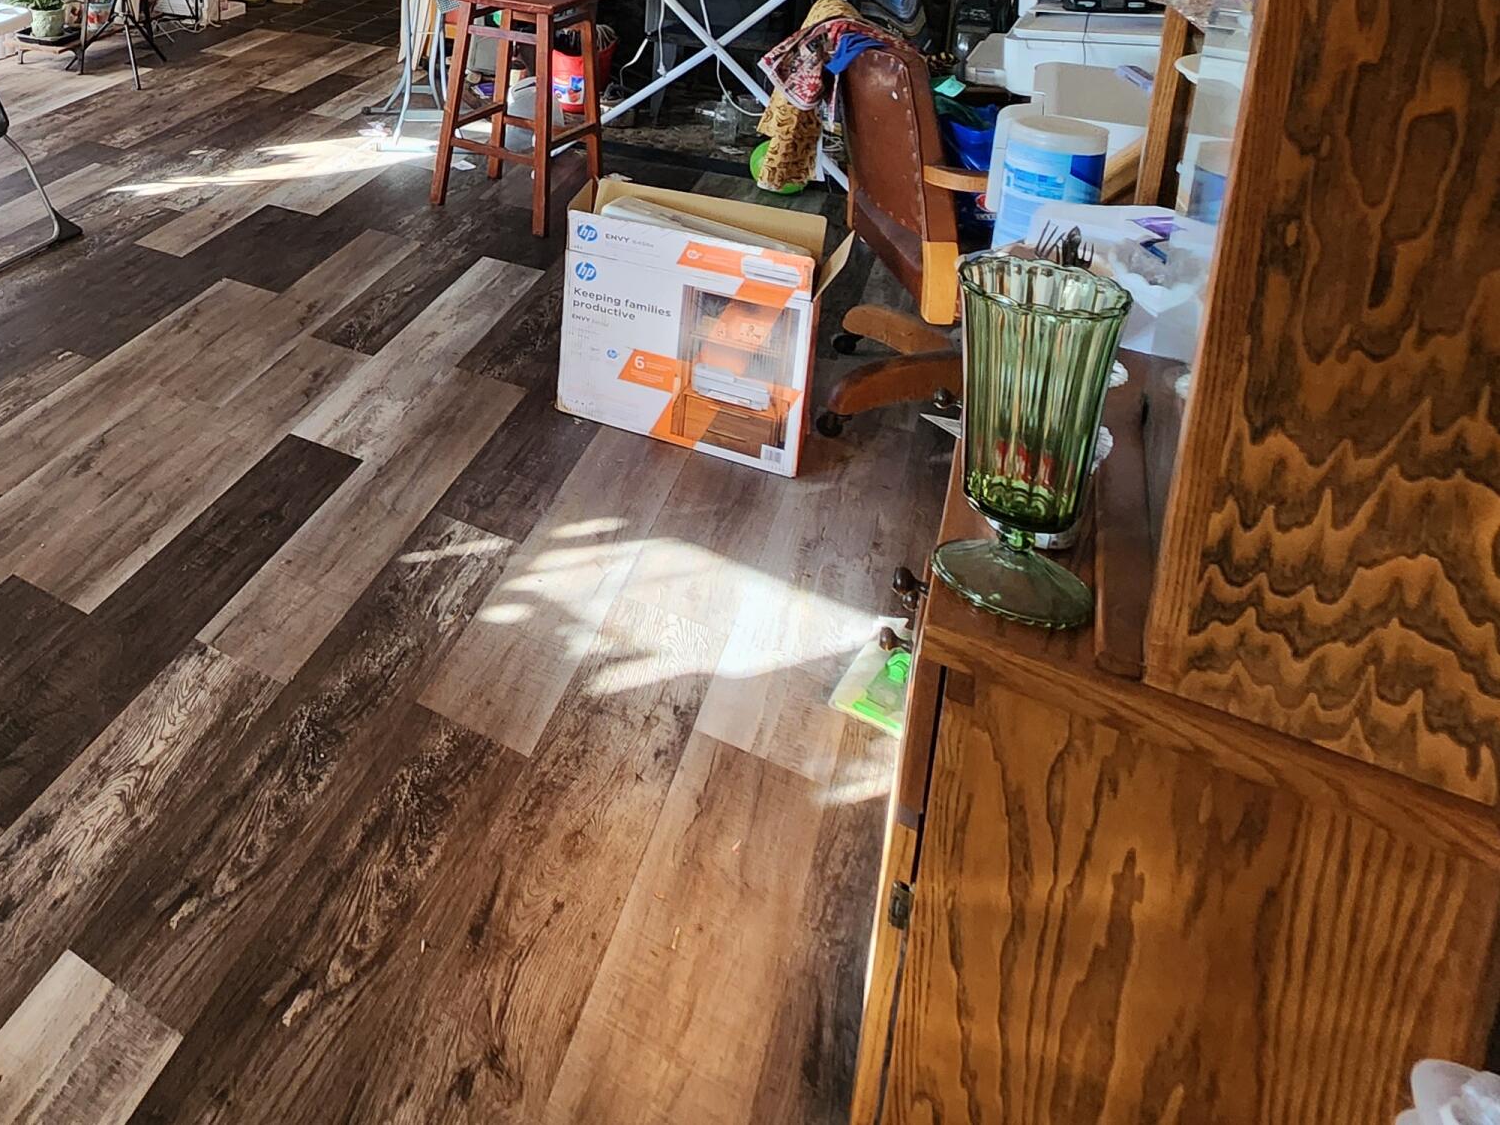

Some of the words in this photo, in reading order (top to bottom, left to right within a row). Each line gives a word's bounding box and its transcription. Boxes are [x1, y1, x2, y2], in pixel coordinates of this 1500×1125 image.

[578, 224, 597, 242] hp
[605, 233, 630, 243] ENVY
[576, 262, 596, 281] hp
[572, 299, 636, 321] productive
[573, 287, 621, 307] Keeping
[625, 299, 672, 318] families
[572, 313, 590, 322] ENVY
[634, 356, 645, 370] 6
